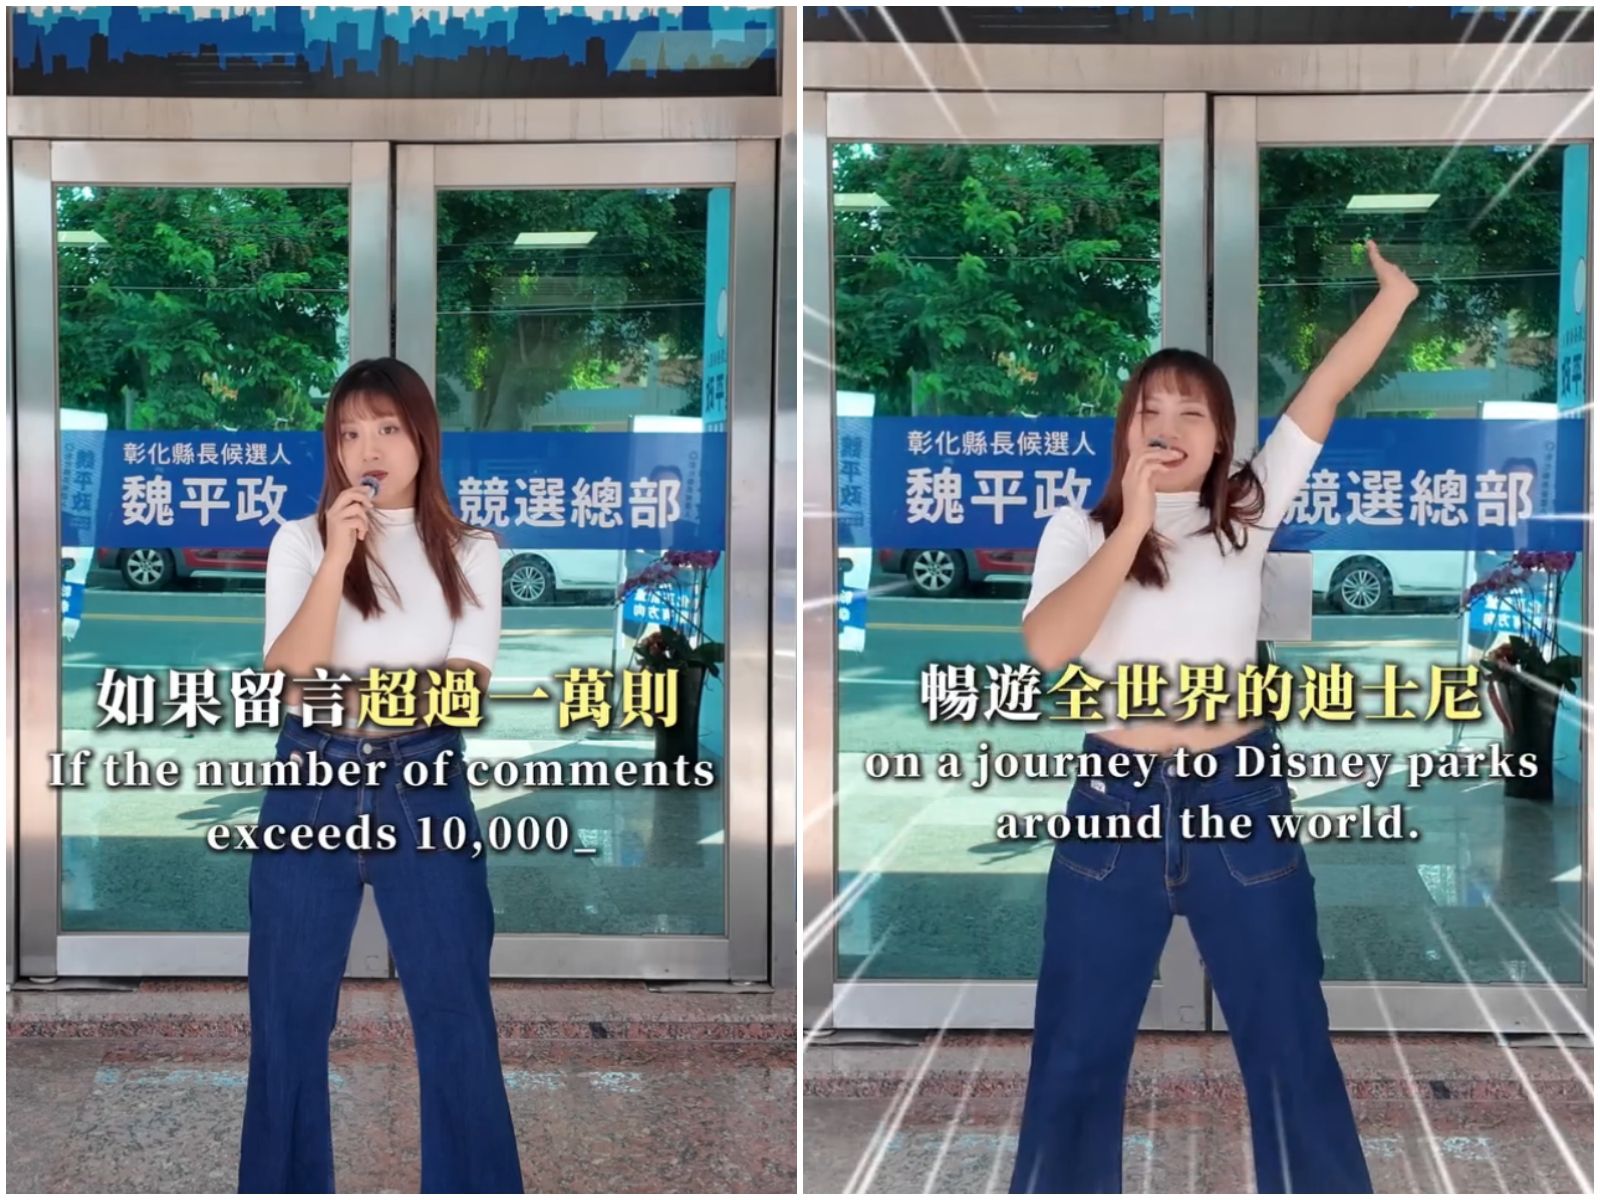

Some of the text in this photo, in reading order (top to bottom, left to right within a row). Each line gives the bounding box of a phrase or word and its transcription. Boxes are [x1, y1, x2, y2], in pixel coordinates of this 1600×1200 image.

[123, 442, 291, 465] 彰化縣長候選人
[907, 431, 1096, 456] 彰化縣長候選人
[122, 475, 288, 526] 魏平政
[458, 476, 681, 528] 競選總部
[906, 467, 1092, 524] 魏平政
[1283, 468, 1534, 526] 競選總部
